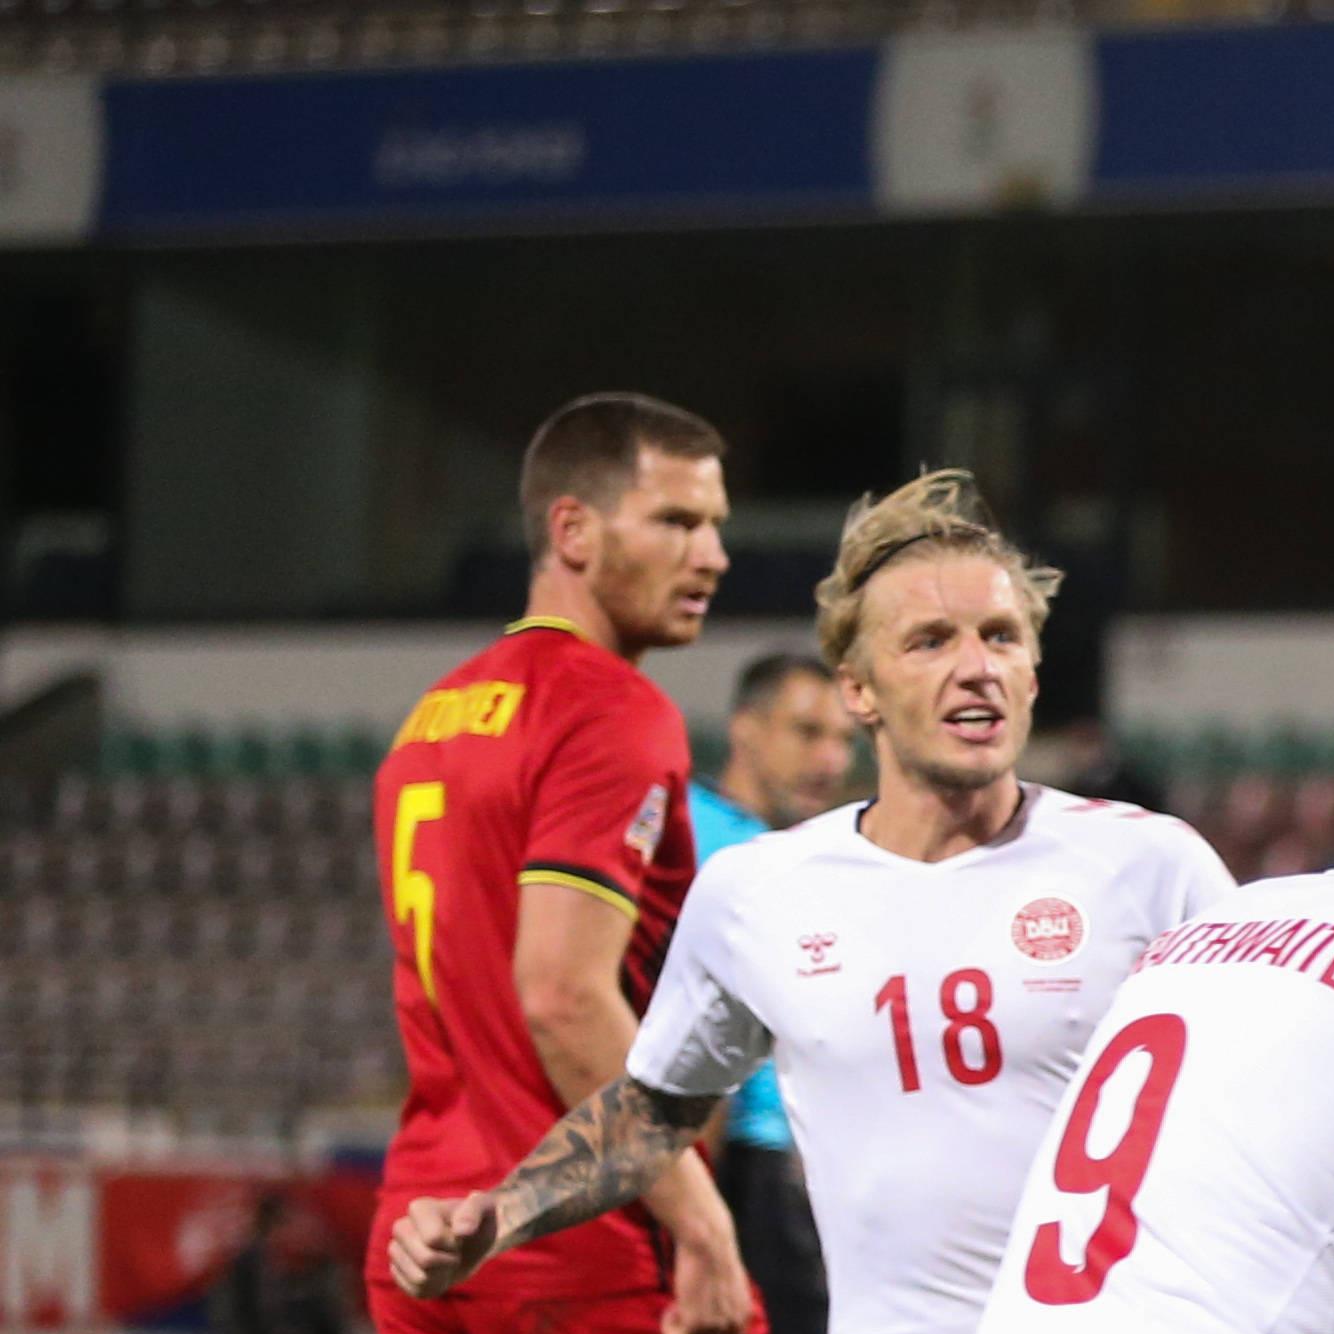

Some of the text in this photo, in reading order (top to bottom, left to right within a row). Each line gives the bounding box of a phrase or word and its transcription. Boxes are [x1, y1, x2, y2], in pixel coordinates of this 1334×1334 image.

[393, 781, 446, 1005] 5
[874, 967, 1003, 1092] 18
[1025, 1013, 1187, 1305] 9
